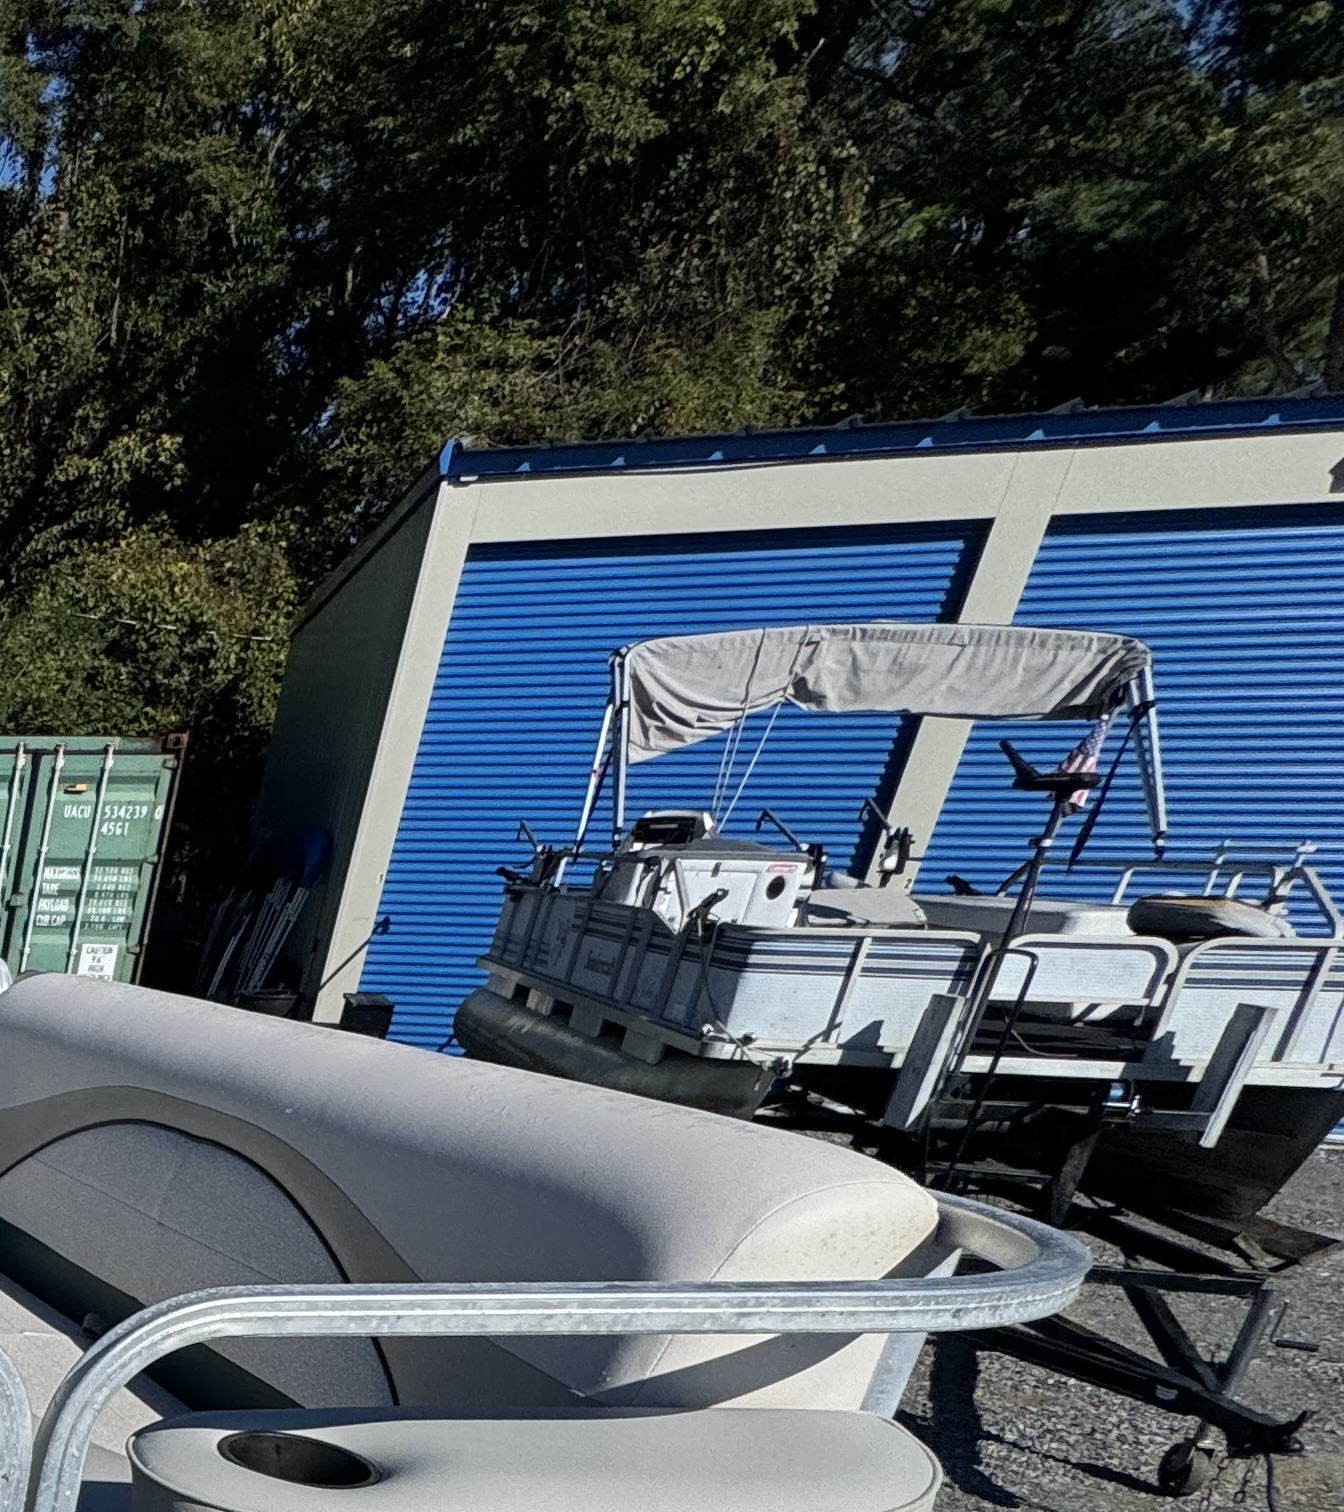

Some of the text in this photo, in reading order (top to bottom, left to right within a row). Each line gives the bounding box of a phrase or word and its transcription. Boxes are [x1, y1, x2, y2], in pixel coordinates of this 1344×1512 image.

[63, 804, 92, 819] UACU
[103, 804, 148, 820] 534239
[903, 878, 913, 890] 2
